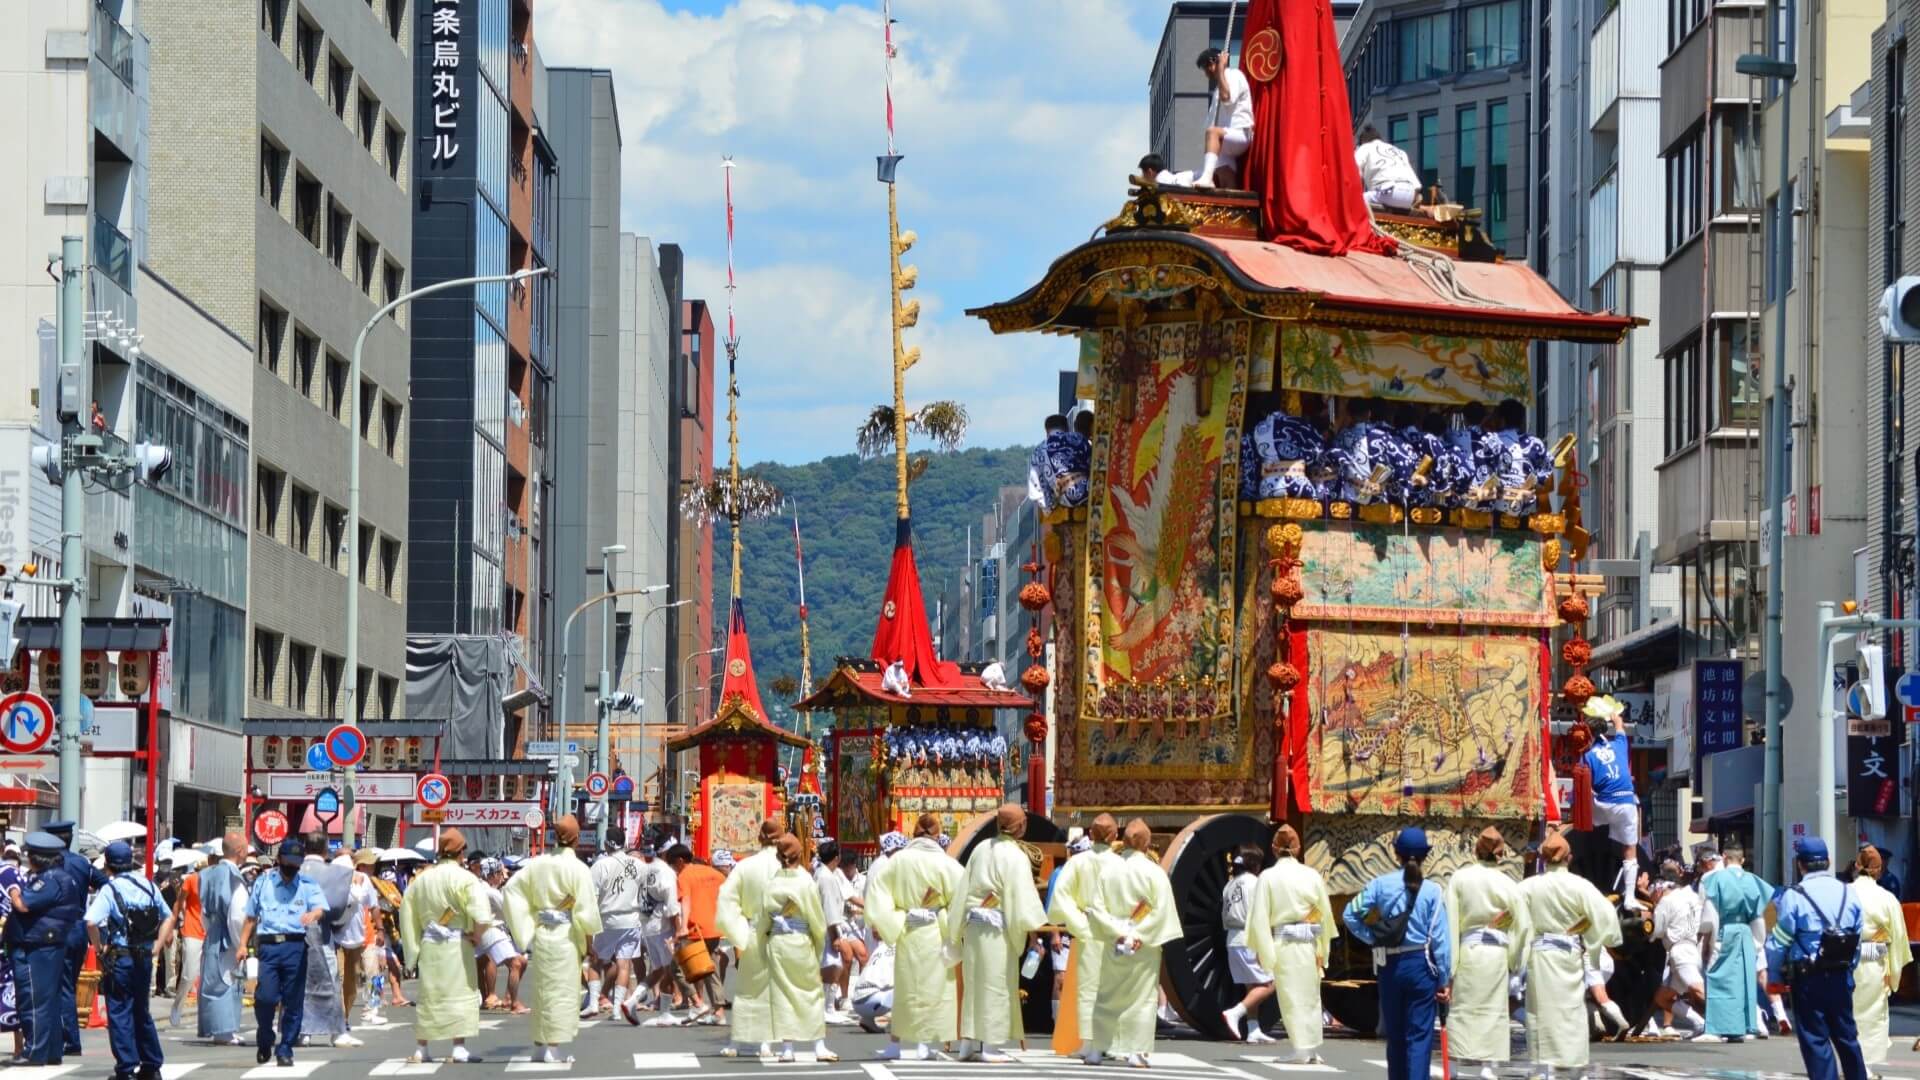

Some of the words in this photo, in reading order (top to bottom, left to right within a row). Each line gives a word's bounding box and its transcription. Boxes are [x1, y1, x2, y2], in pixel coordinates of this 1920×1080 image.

[1702, 667, 1717, 745] 池坊文化
[1721, 667, 1736, 745] 池坊短期
[444, 808, 521, 820] ホリーズカフェ
